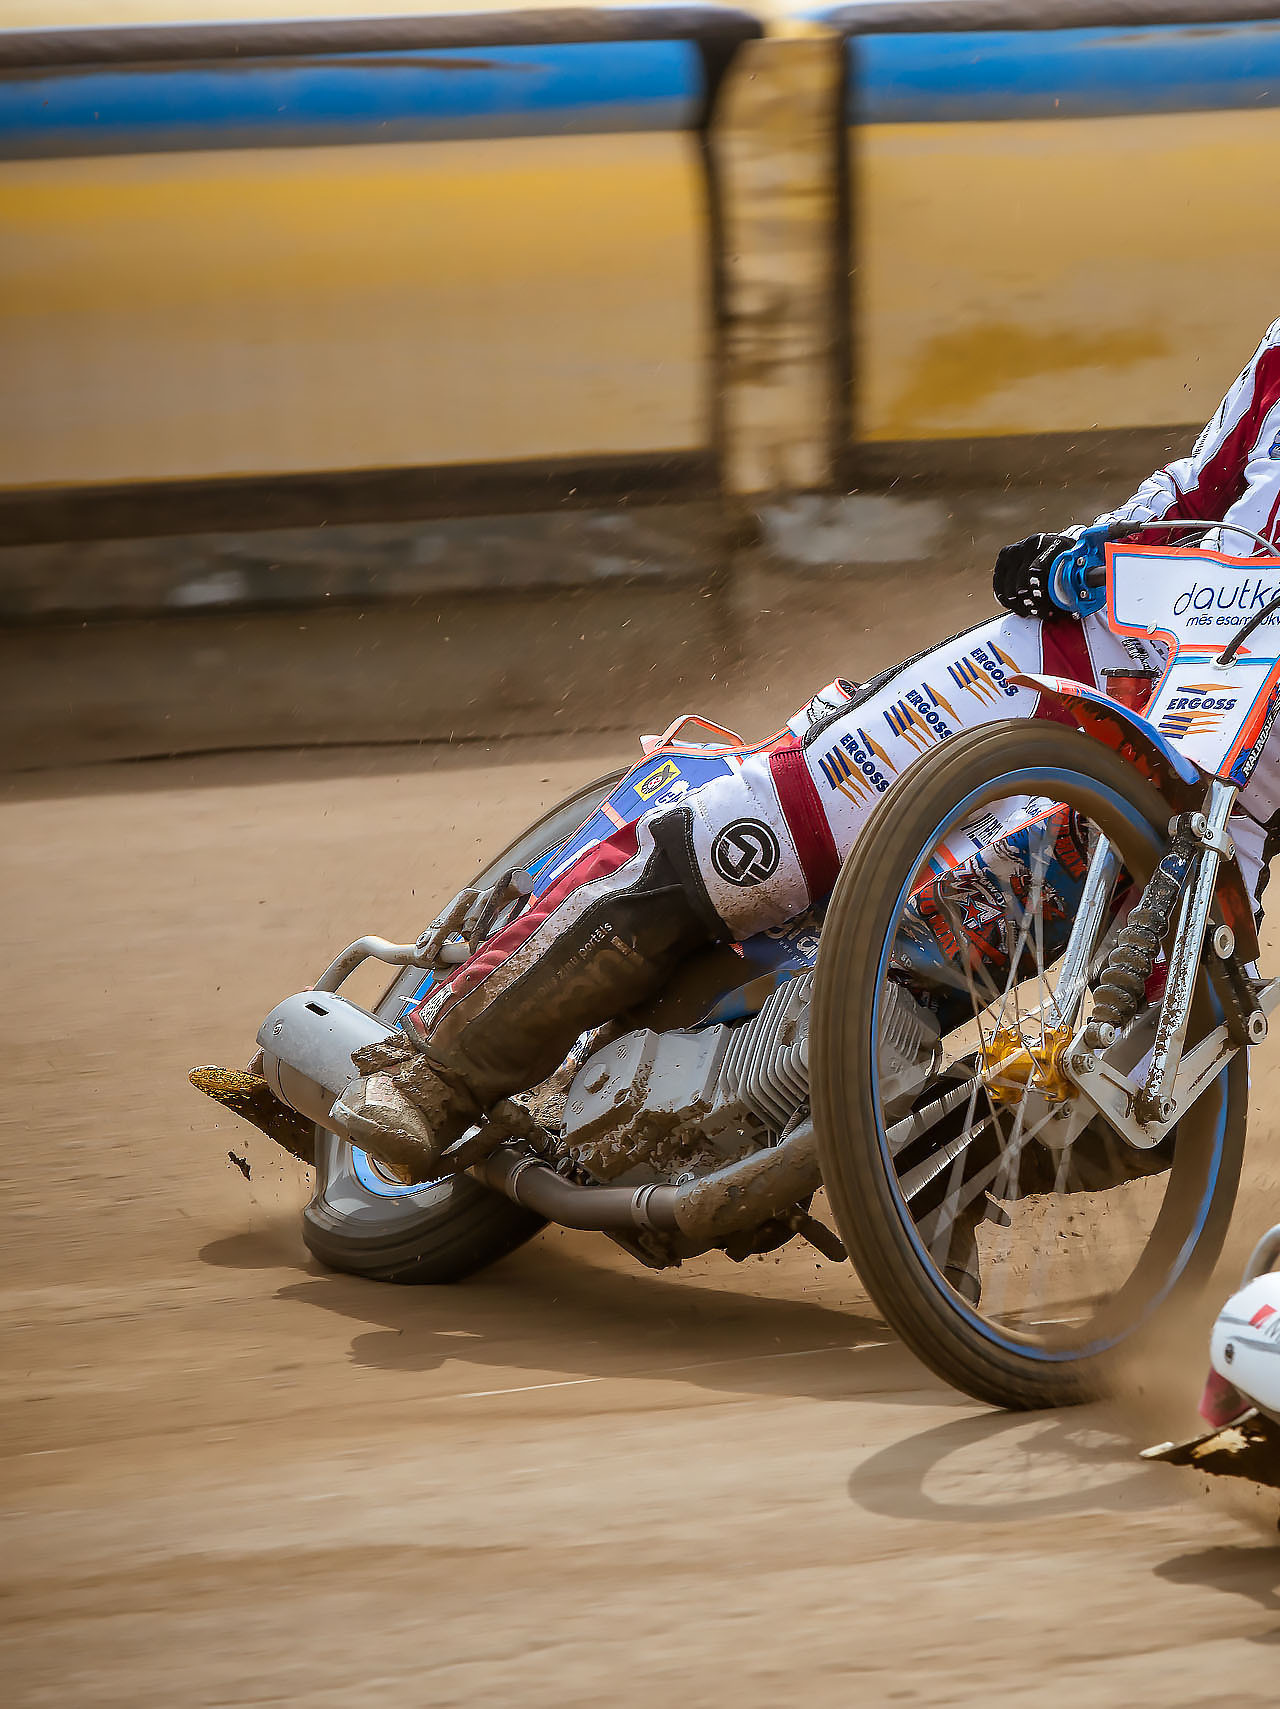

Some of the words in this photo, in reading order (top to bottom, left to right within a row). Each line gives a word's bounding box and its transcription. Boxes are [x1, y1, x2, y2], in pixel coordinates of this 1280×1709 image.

[1186, 613, 1212, 627] mēs
[968, 647, 1019, 698] ERGOSS
[903, 689, 953, 740] ERGOSS
[1166, 697, 1238, 711] ERGOSS
[838, 732, 891, 793] ERGOSS
